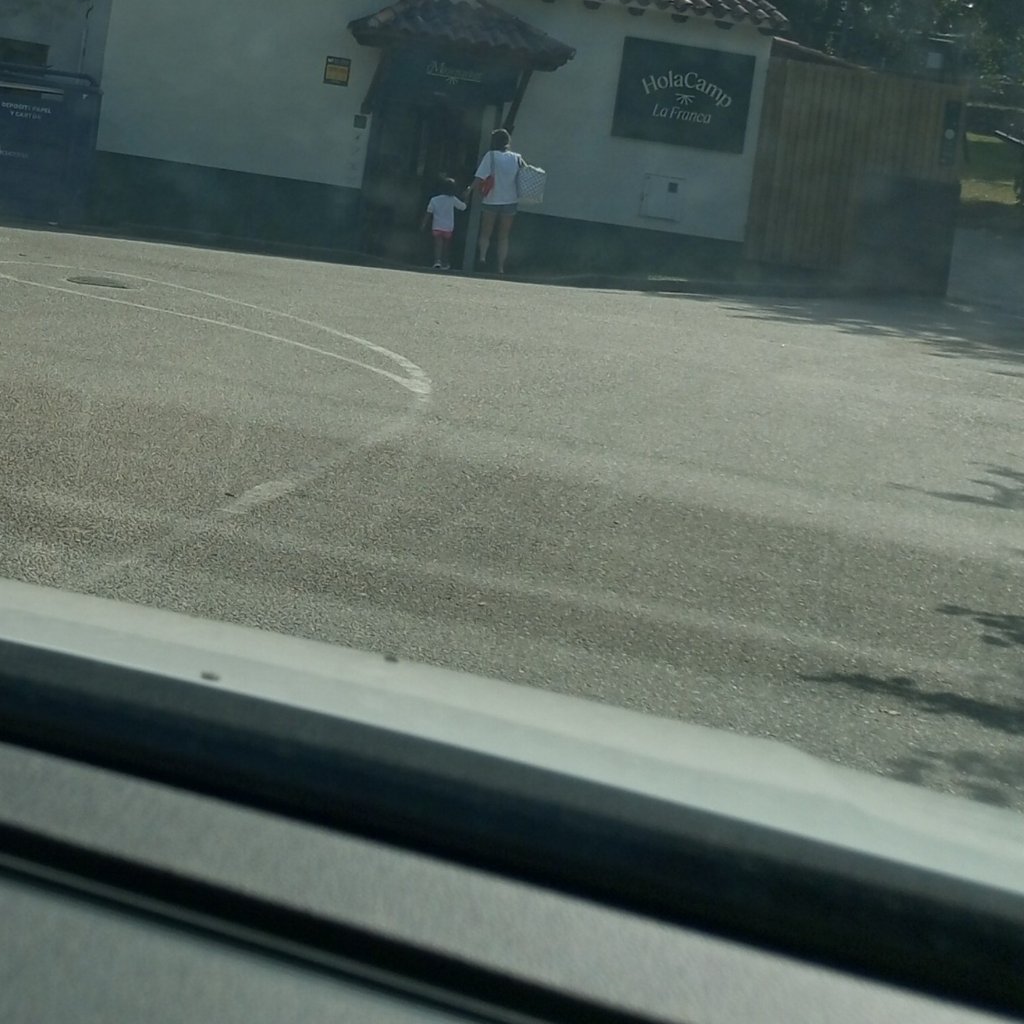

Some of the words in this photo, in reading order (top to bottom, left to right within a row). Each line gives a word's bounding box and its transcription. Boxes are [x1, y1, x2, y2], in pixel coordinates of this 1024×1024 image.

[641, 70, 732, 108] HolaCamp
[652, 103, 668, 118] La
[669, 105, 712, 124] Franca
